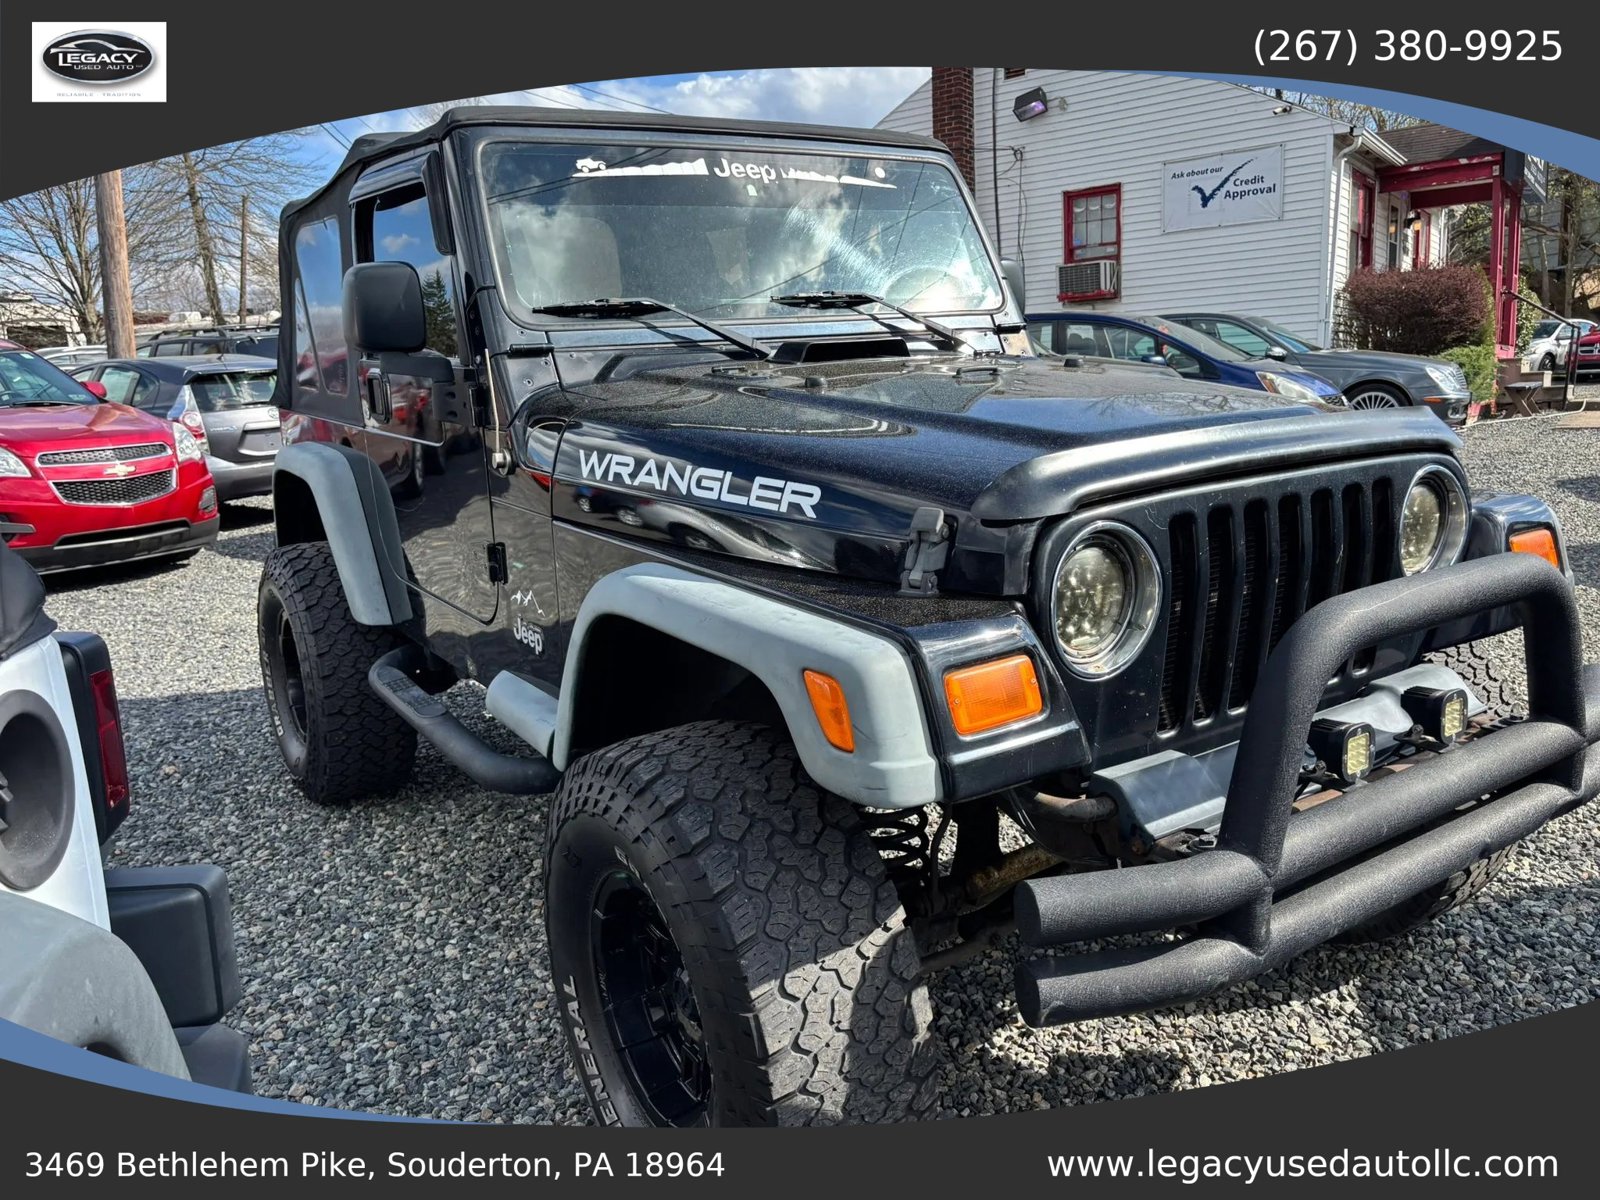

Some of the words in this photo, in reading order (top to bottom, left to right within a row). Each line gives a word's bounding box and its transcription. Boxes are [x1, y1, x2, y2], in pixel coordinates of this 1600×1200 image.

[713, 157, 777, 182] Jeep
[1170, 171, 1185, 180] Ask
[1186, 168, 1209, 178] about
[1209, 166, 1224, 174] our
[1224, 183, 1276, 200] Approval
[1233, 175, 1265, 187] Credit
[579, 449, 822, 519] WRANGLER
[513, 615, 543, 655] Jeep
